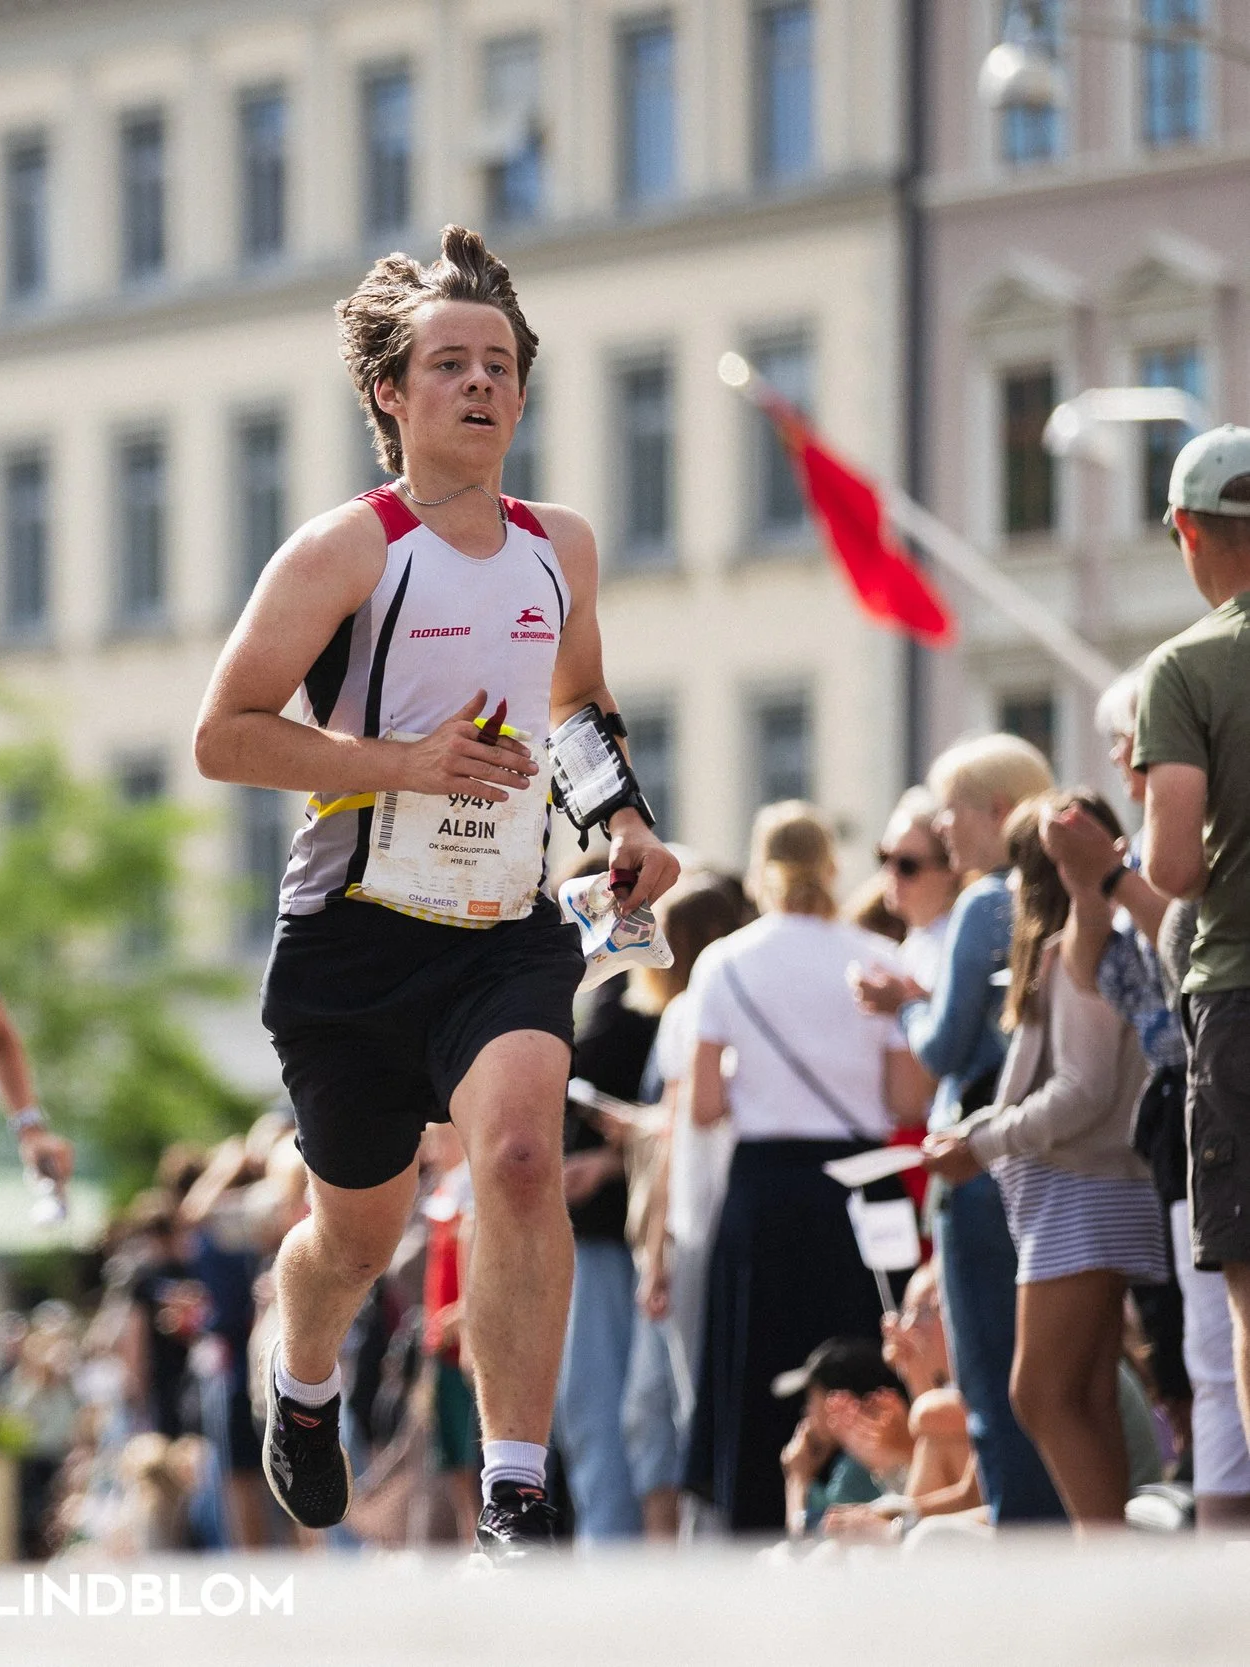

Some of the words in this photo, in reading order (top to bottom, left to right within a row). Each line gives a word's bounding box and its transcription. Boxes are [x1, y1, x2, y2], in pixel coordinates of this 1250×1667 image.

[409, 626, 471, 639] noname
[510, 631, 519, 639] OK
[437, 818, 496, 839] ALBIN
[428, 842, 439, 850] OK
[440, 844, 501, 856] SKOGSHJORTARNA
[408, 893, 459, 908] CHALMERS
